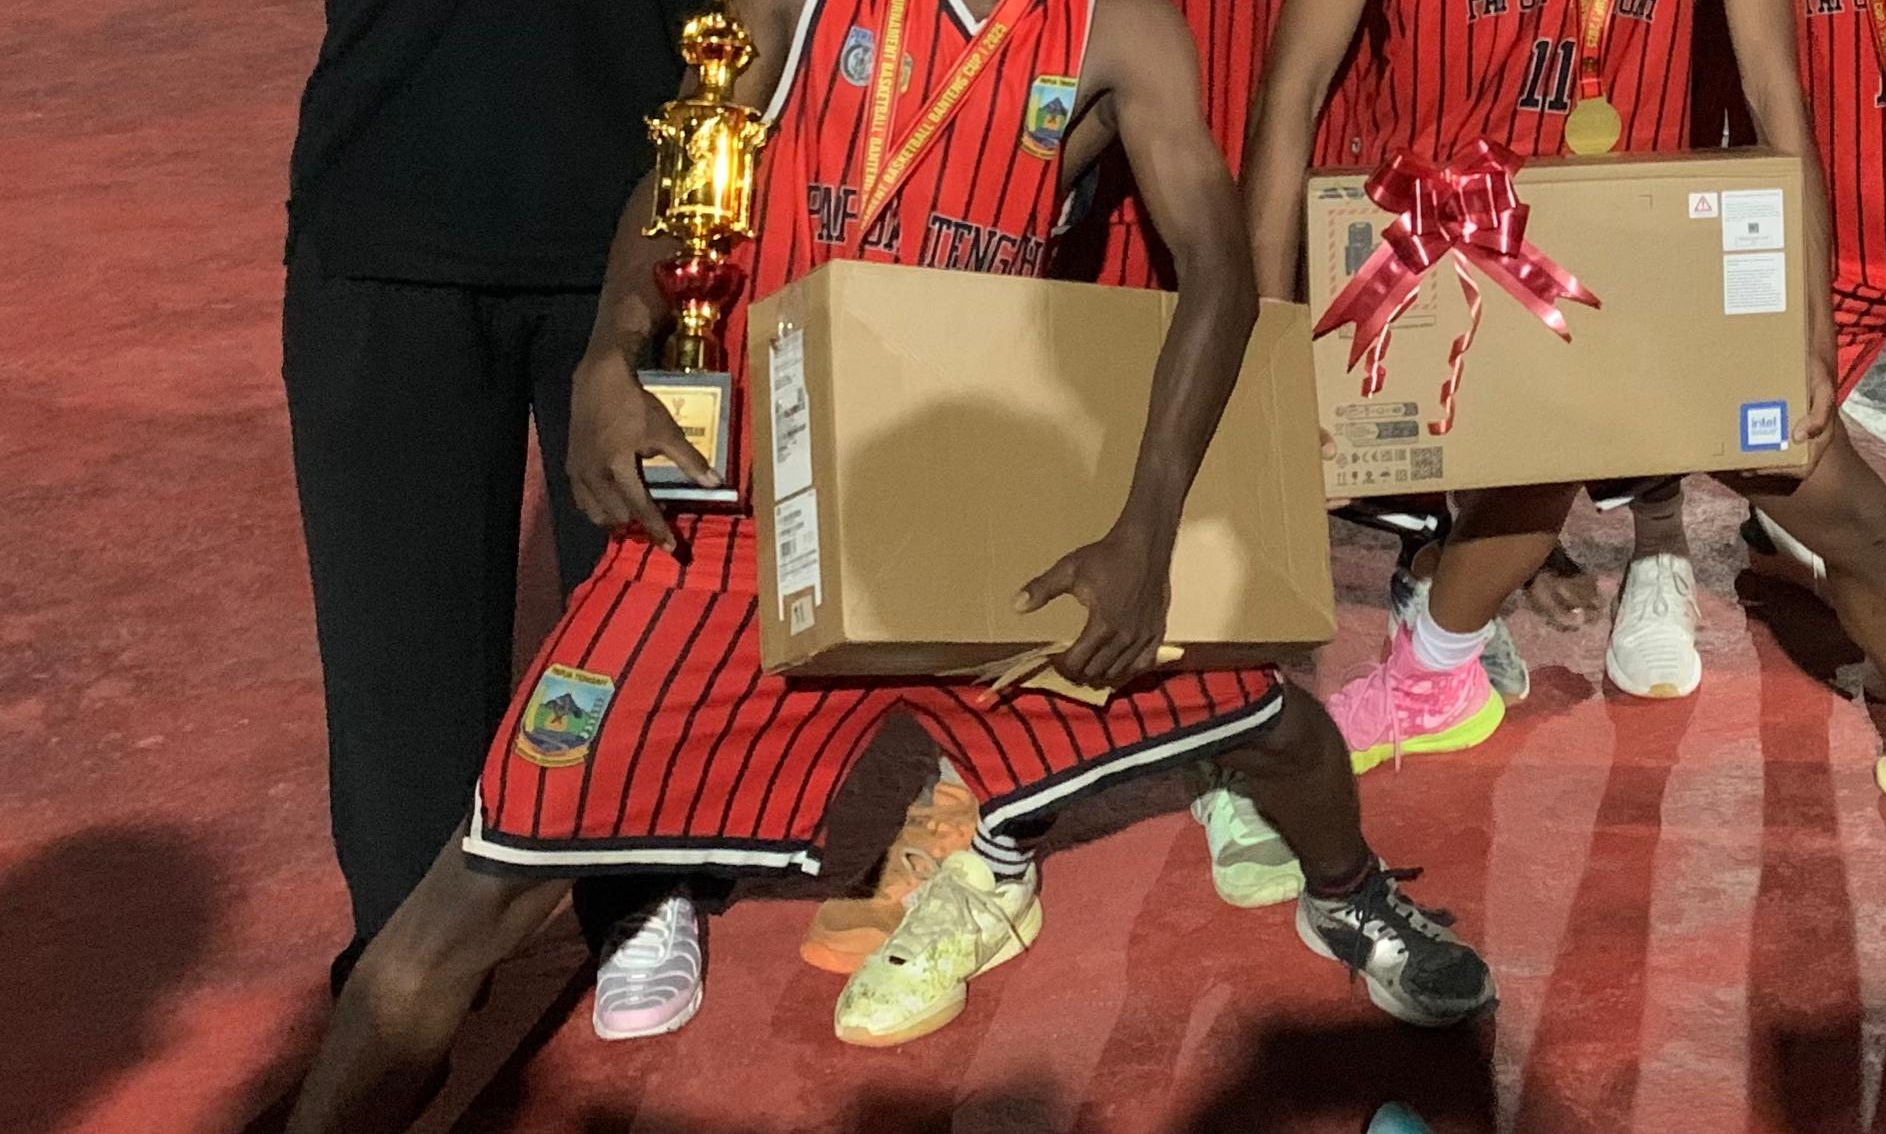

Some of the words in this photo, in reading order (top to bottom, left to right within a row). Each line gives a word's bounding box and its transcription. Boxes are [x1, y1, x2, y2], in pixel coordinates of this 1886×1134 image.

[872, 62, 894, 133] BASKETBALL
[882, 121, 934, 185] BASKETBALL
[925, 74, 968, 123] BANTENG
[961, 51, 984, 77] CUP
[981, 21, 1007, 50] 2025
[1518, 36, 1578, 115] 11
